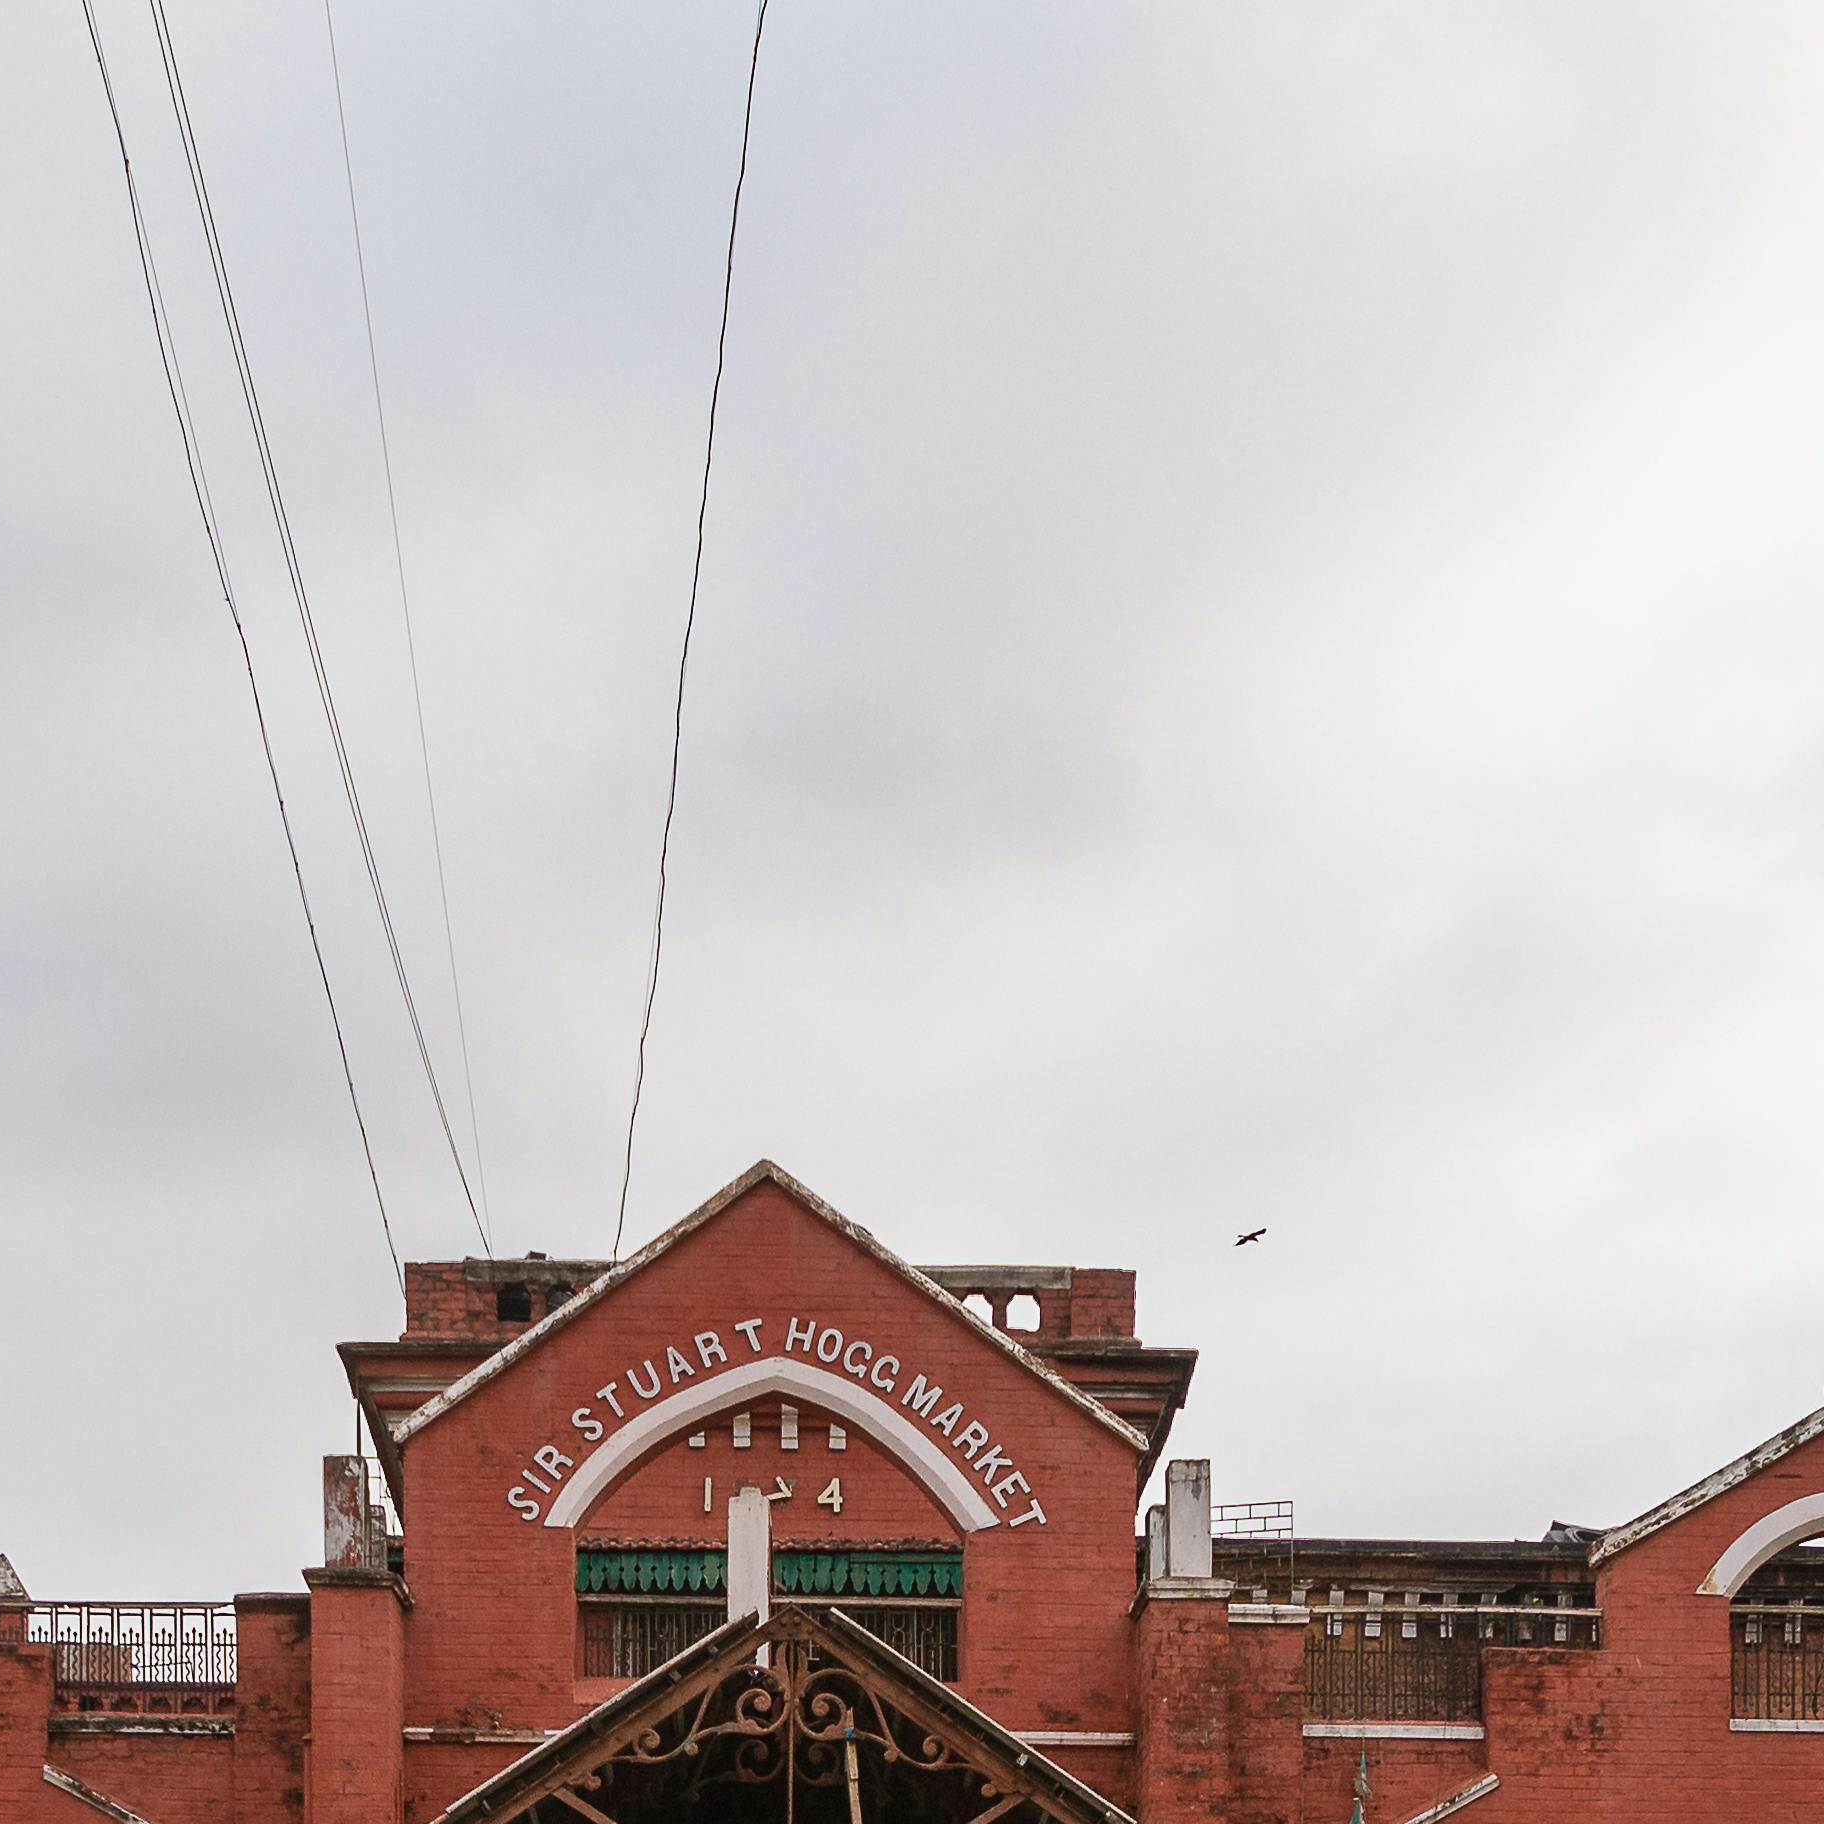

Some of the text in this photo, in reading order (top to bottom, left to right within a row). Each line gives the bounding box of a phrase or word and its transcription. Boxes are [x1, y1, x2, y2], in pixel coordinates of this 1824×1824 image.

[507, 1316, 1047, 1528] SIR STUART HOGG MARKET
[704, 1476, 843, 1513] 174
